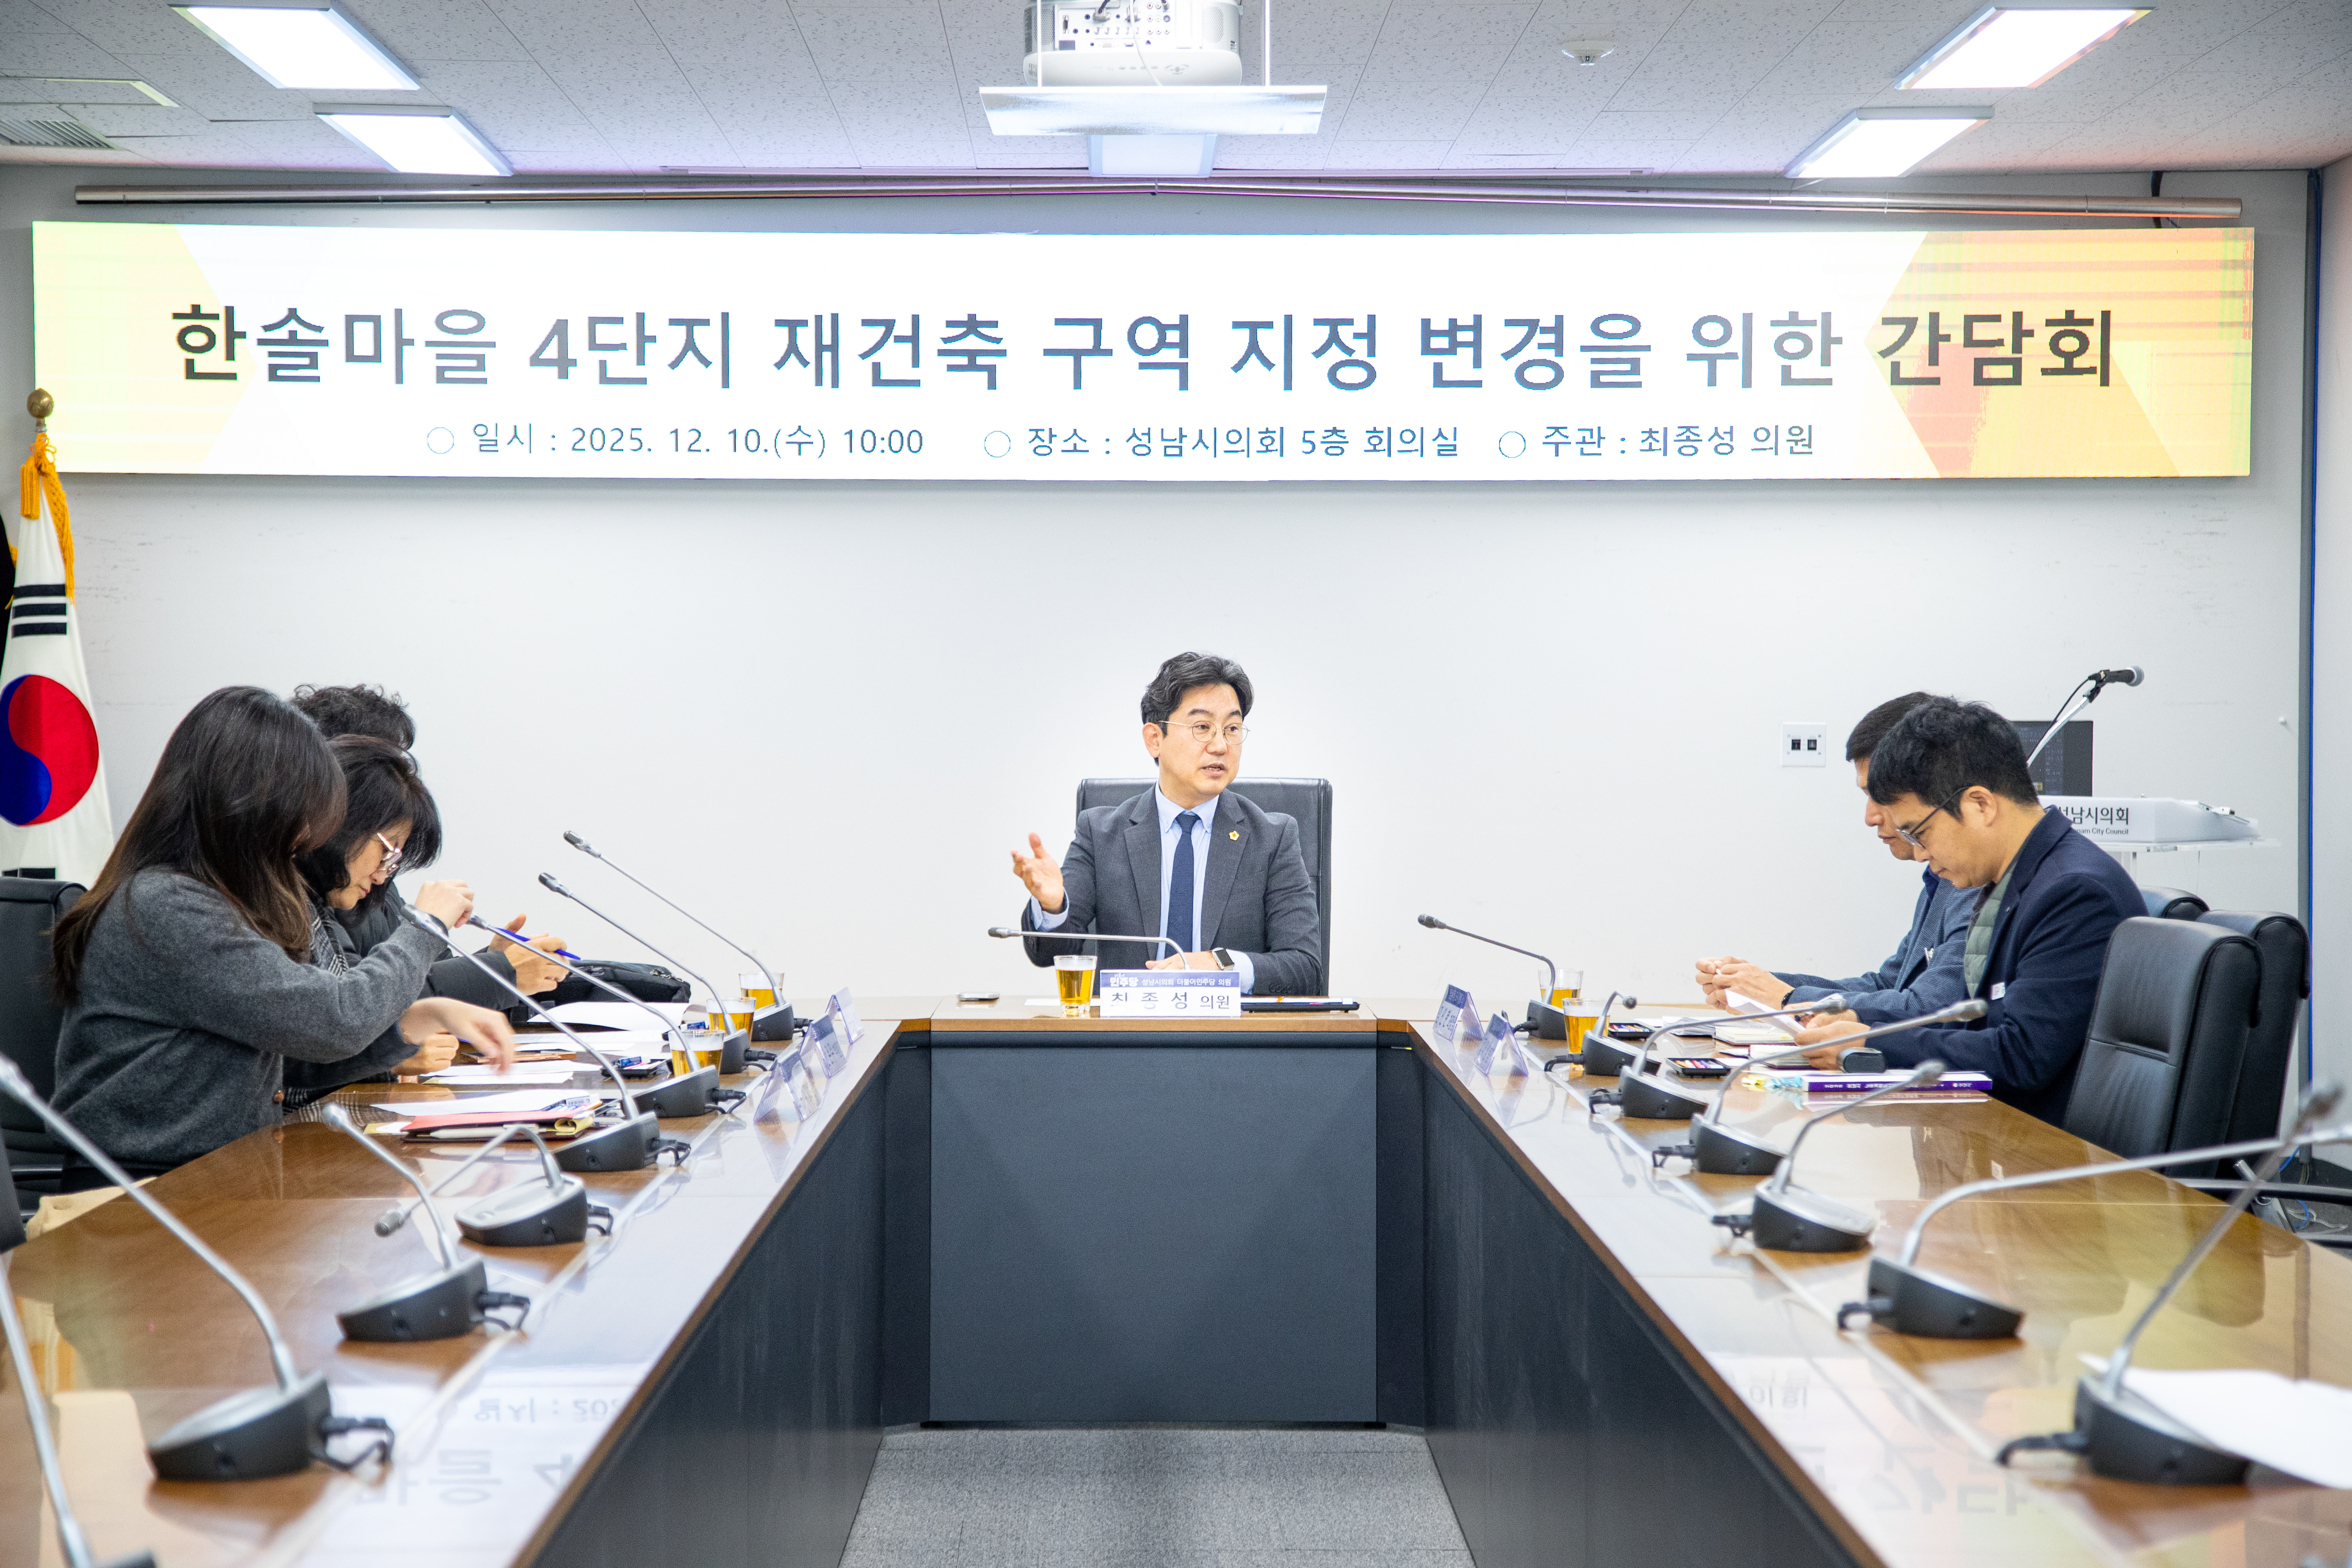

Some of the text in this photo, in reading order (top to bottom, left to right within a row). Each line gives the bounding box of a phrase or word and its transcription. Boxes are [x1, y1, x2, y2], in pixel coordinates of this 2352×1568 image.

[172, 304, 2111, 391] 한솔마을 4단지 재건축 구역 지정 변경을 위한 간담회
[473, 423, 533, 454] 일시
[571, 427, 652, 453] 2025.
[669, 428, 711, 453] 12.
[727, 425, 826, 459] 10.(수)
[843, 429, 924, 454] 10:00
[1028, 427, 1090, 457] 장소
[1125, 426, 1285, 459] 성남시의회
[1301, 426, 1350, 457] 5층
[1363, 426, 1458, 458] 회의실
[1541, 426, 1607, 458] 주관
[1639, 425, 1735, 457] 최종성
[1750, 424, 1813, 456] 의원
[2092, 827, 2104, 836] City
[1110, 977, 1139, 987] 민주당
[1142, 978, 1231, 986] 성남시의회 더불어민주당 의원
[1200, 995, 1229, 1010] 의원
